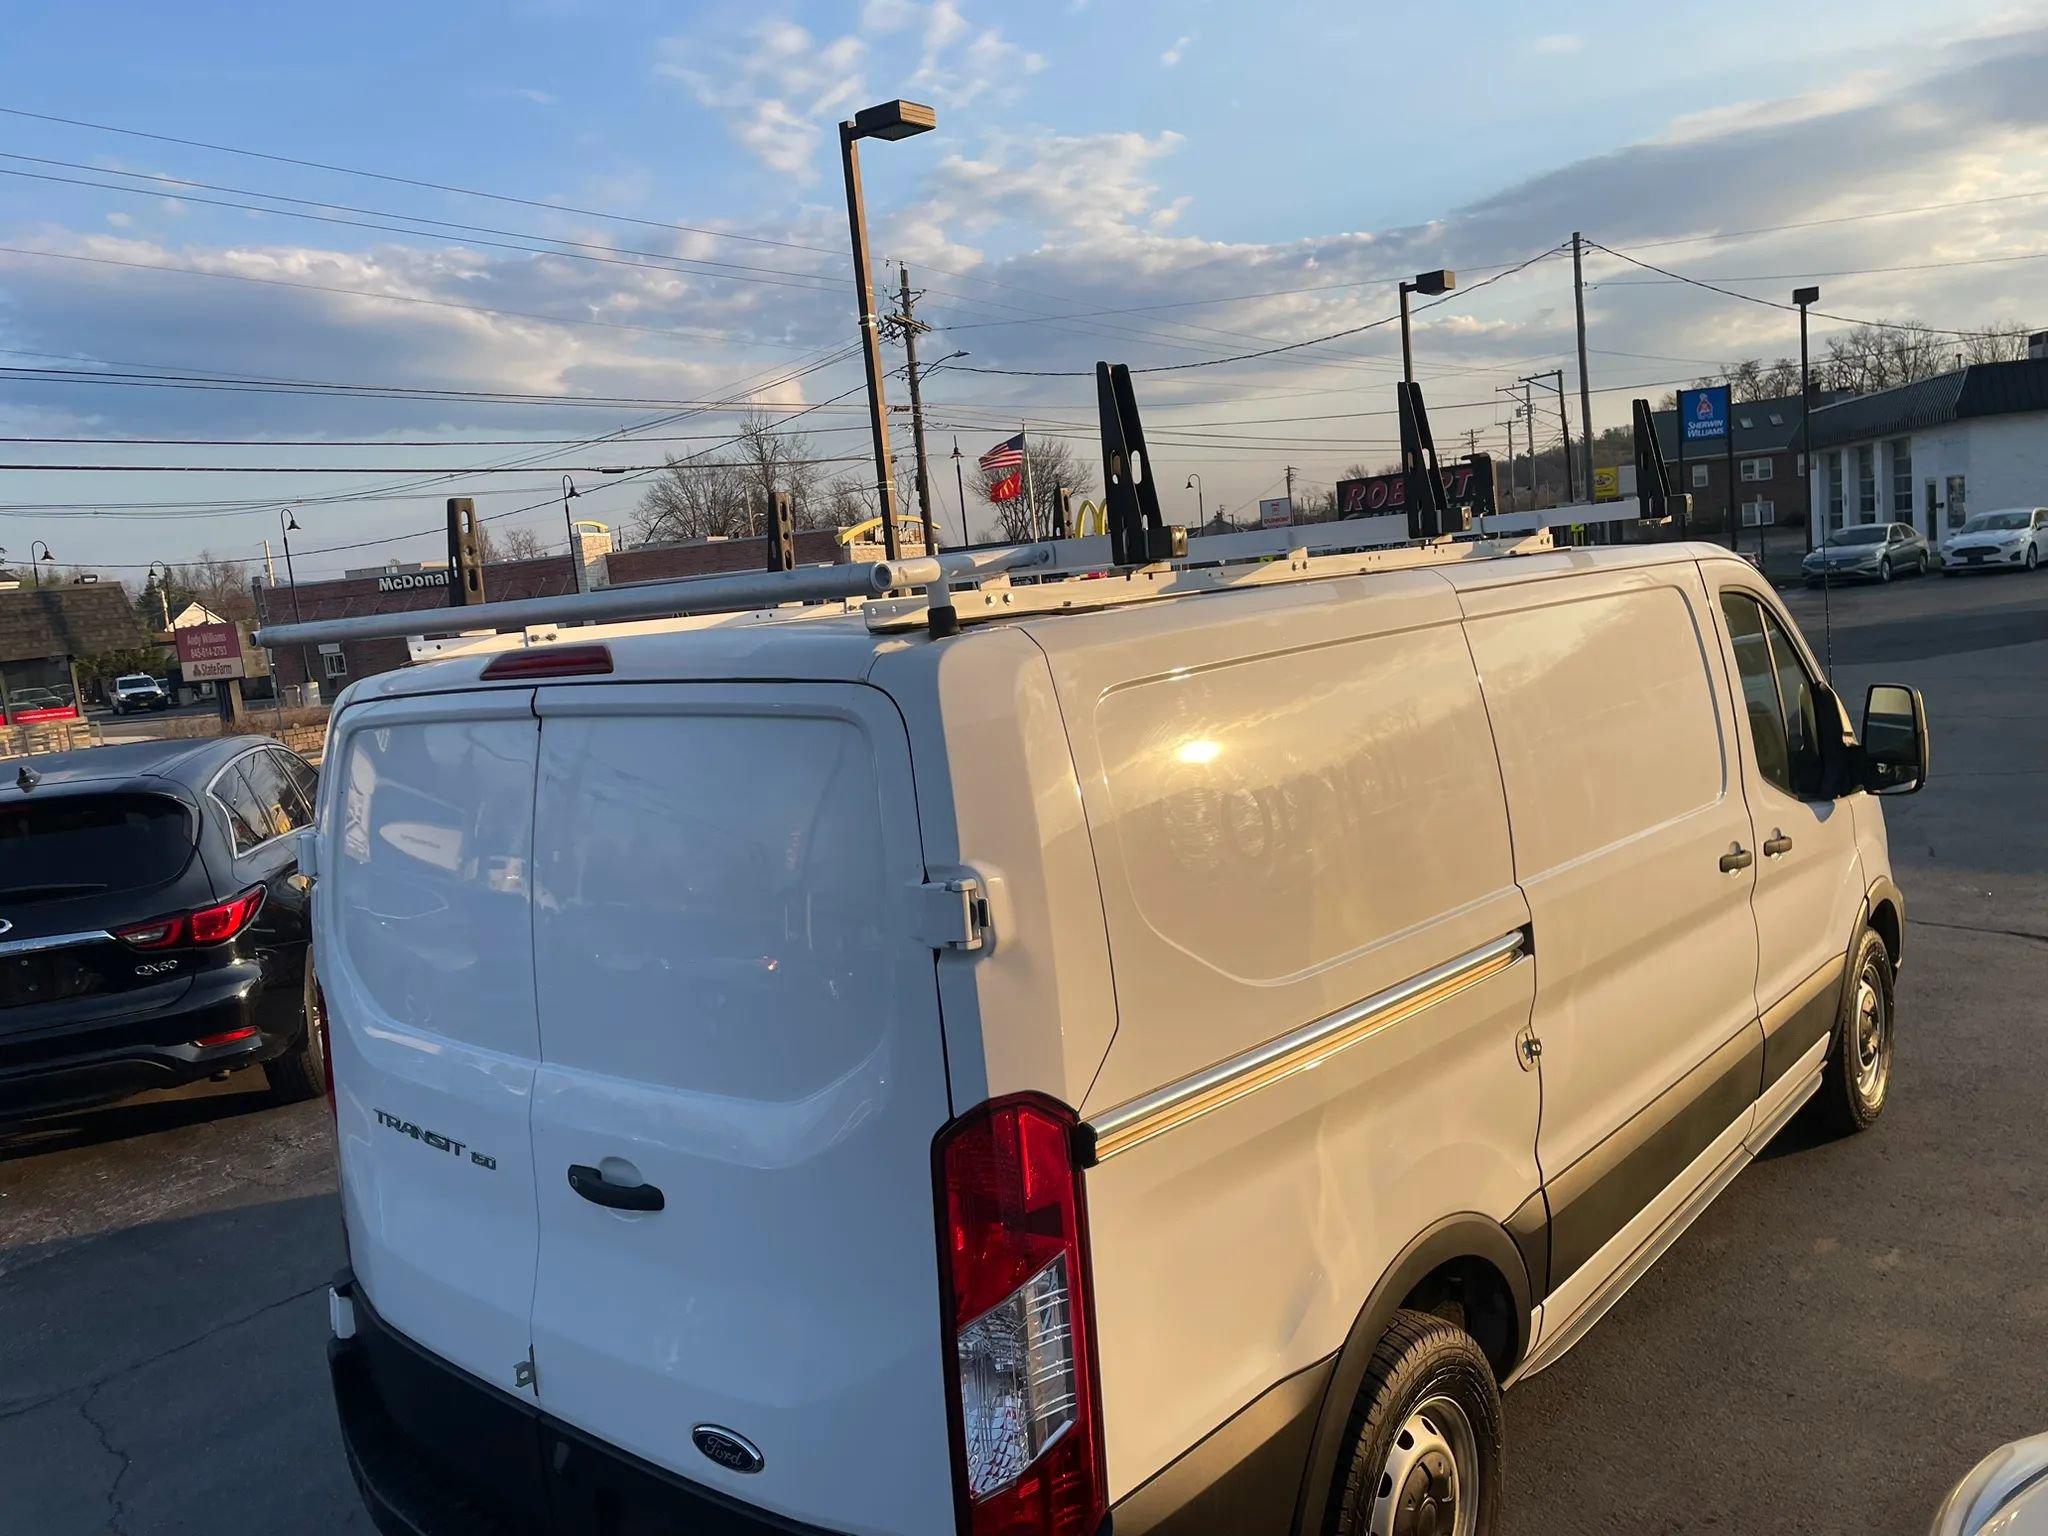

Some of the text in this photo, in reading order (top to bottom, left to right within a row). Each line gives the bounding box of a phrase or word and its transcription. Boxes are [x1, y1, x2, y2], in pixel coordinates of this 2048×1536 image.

[1688, 420, 1724, 430] SHERWIN
[1688, 427, 1724, 438] WILLIAMS
[1344, 470, 1473, 511] ROBRT
[379, 571, 449, 591] McDonal
[134, 960, 178, 976] QX50
[373, 1108, 467, 1156] TRANSIT
[704, 1435, 742, 1466] Ford
